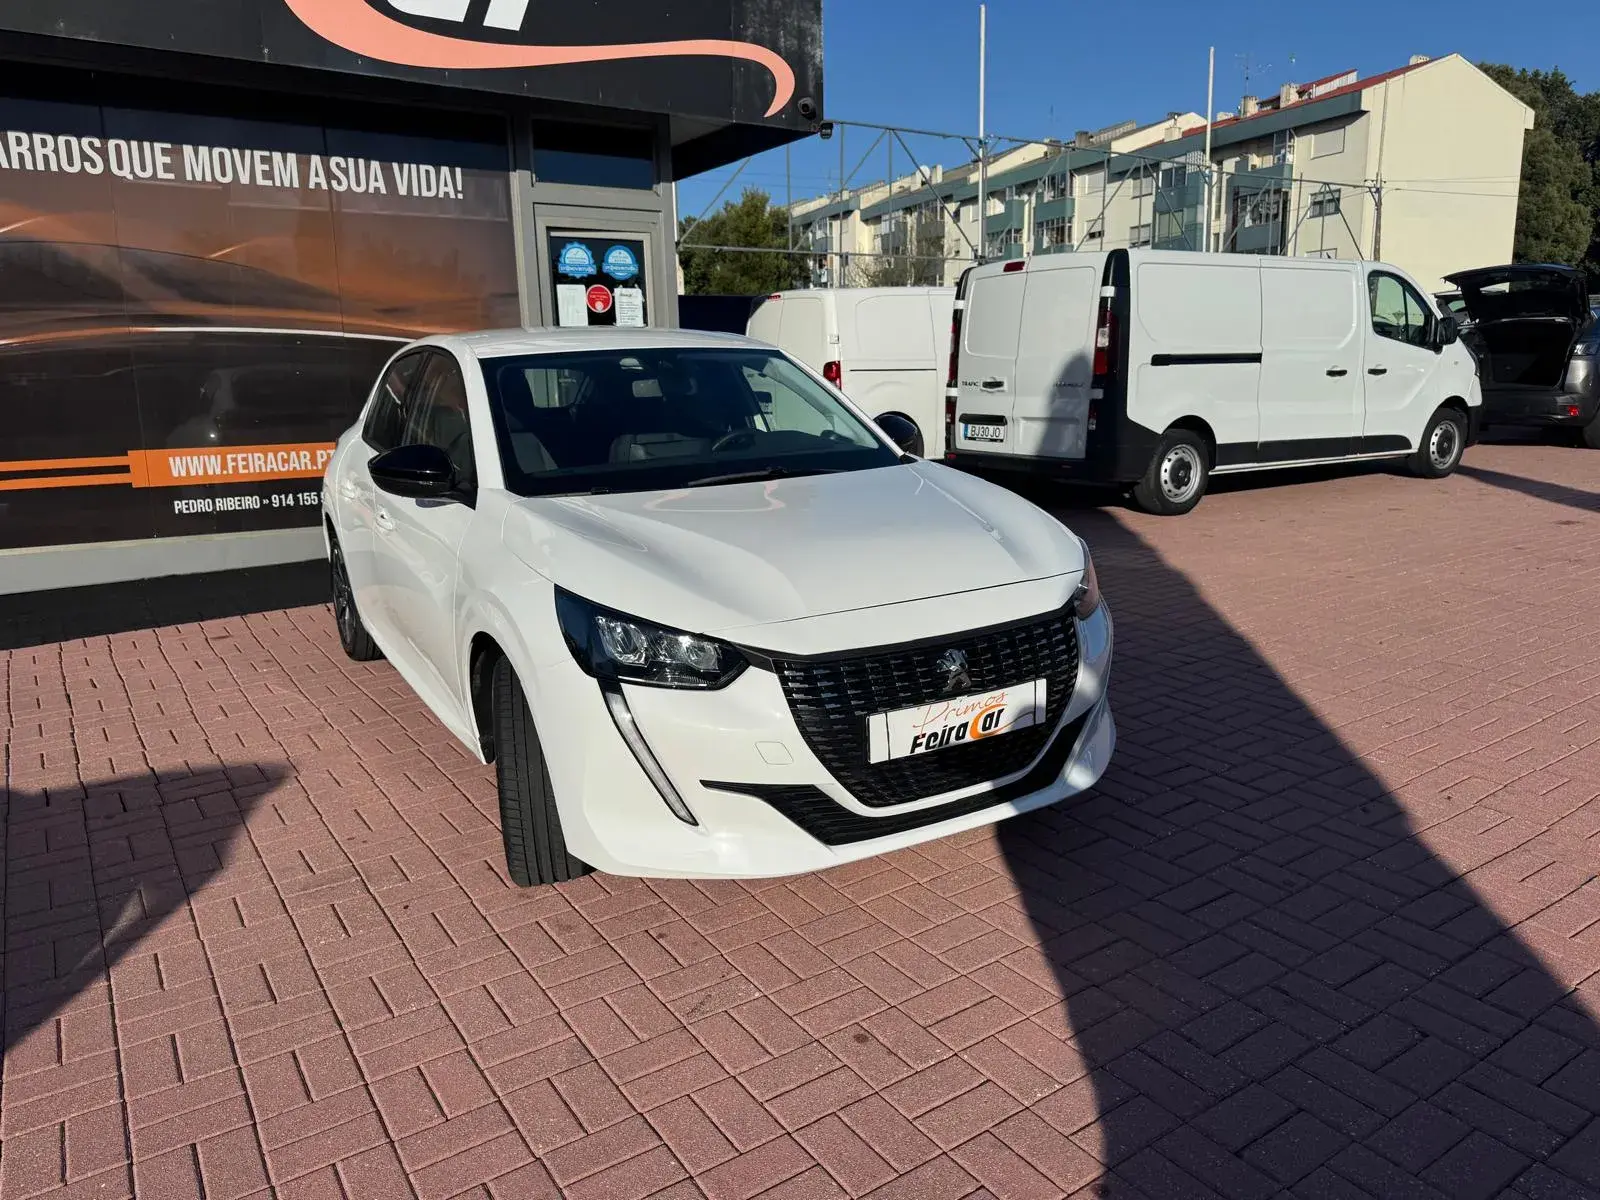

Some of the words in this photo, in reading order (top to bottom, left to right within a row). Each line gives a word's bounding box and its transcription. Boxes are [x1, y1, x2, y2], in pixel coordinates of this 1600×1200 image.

[108, 138, 176, 182] QUE
[183, 144, 299, 188] MOVEM
[308, 155, 328, 191] A
[331, 156, 387, 195] SUA
[391, 162, 464, 200] VIDA!
[174, 498, 213, 515] PEDRO
[215, 495, 261, 513] RIBEIRO
[271, 493, 295, 508] 914
[297, 491, 319, 506] 155
[912, 691, 1009, 738] Primos
